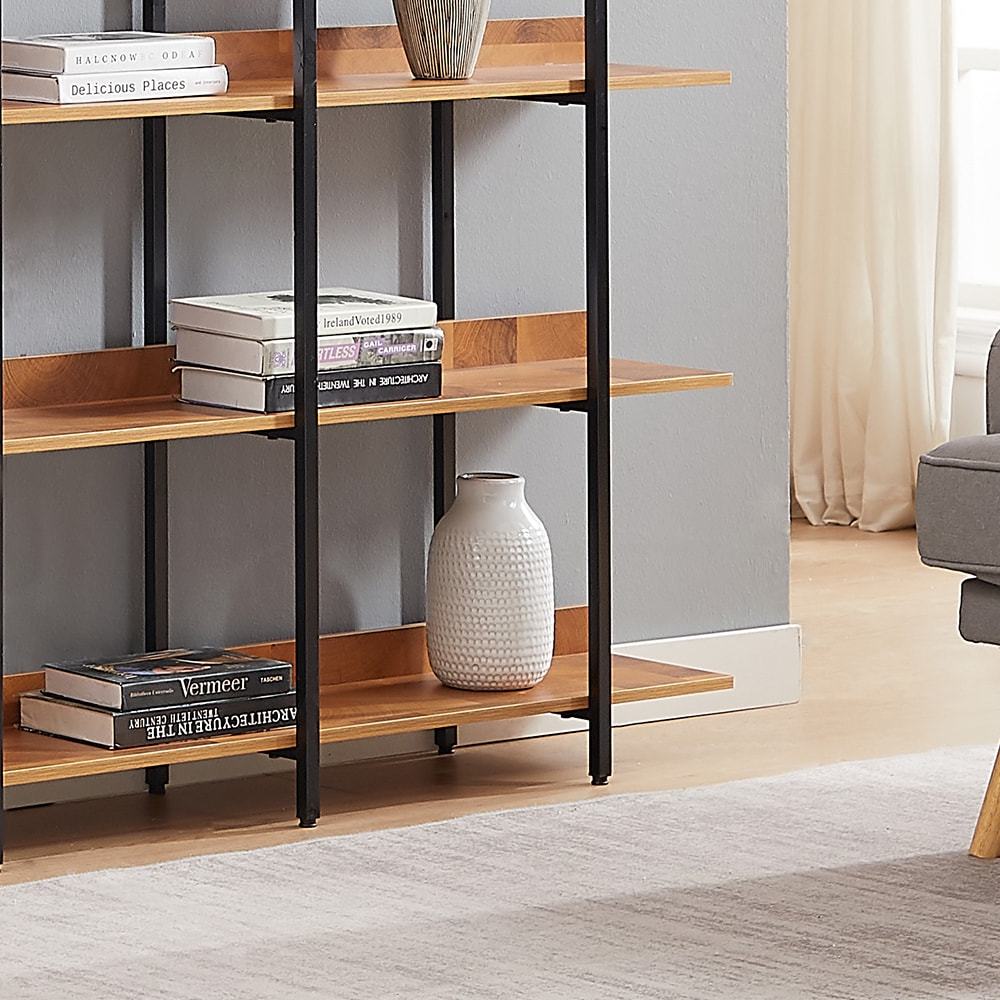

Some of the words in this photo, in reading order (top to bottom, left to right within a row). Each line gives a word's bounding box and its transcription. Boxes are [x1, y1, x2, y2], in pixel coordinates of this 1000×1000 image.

[71, 80, 136, 96] Delicious
[143, 78, 186, 92] Places
[318, 345, 356, 361] RTLESS
[353, 378, 366, 388] THE
[369, 377, 377, 387] IN
[379, 373, 429, 386] ARCHITECTURE
[179, 676, 249, 698] Vermeer
[260, 675, 284, 684] TASCHEN
[128, 713, 168, 729] CENTURY
[170, 708, 219, 723] TWENTIETH
[147, 725, 174, 740] THE
[178, 720, 193, 736] IN
